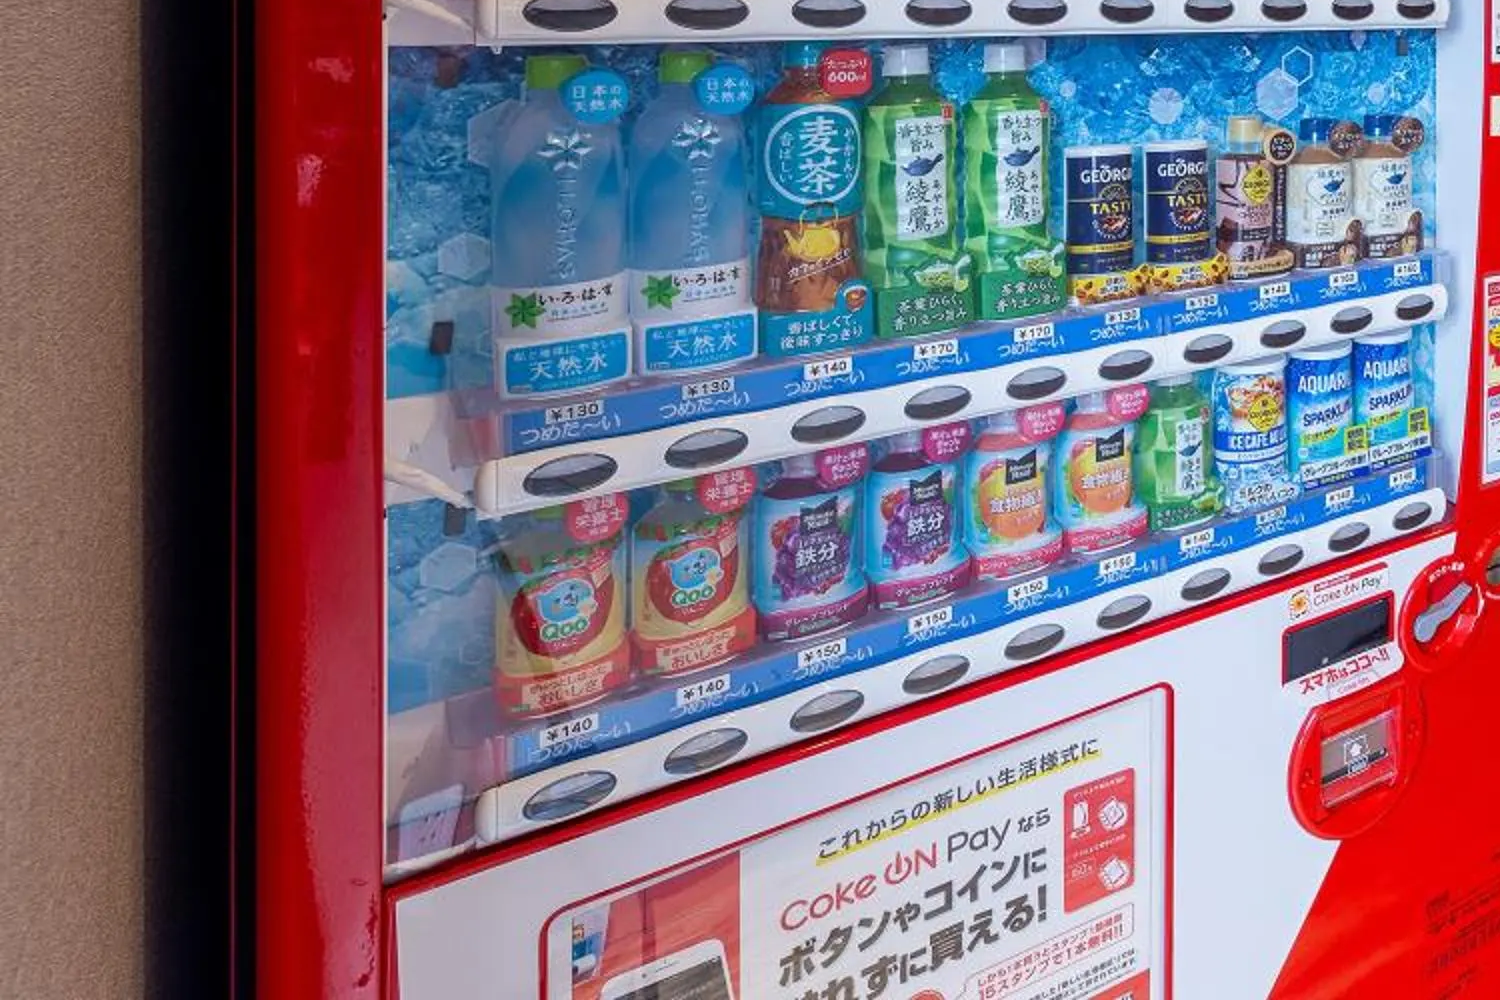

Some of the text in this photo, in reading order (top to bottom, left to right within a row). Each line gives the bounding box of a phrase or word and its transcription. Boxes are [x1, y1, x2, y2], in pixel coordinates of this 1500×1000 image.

[796, 116, 841, 195] 麦茶
[1081, 165, 1131, 183] GEORG
[1158, 159, 1206, 177] GEORG
[669, 333, 737, 357] 天然水
[528, 352, 608, 381] 天然水
[809, 360, 847, 375] ¥140
[1364, 357, 1409, 379] AQUAR
[687, 380, 730, 396] ¥130
[1298, 371, 1350, 394] AQUAR
[1369, 383, 1413, 411] SPARKL
[551, 403, 598, 420] ¥130
[1303, 400, 1351, 427] SPARKL
[907, 513, 944, 537] 鉄分
[795, 541, 838, 568] 鉄分
[683, 680, 725, 699] ¥140
[546, 718, 592, 741] ¥140
[817, 738, 1100, 858] これからの新しい生活様式に
[779, 873, 877, 932] Coke
[884, 841, 939, 886] ON
[947, 818, 1012, 862] Pay
[1017, 807, 1051, 834] なら
[778, 847, 1048, 987] ボタンやコインに
